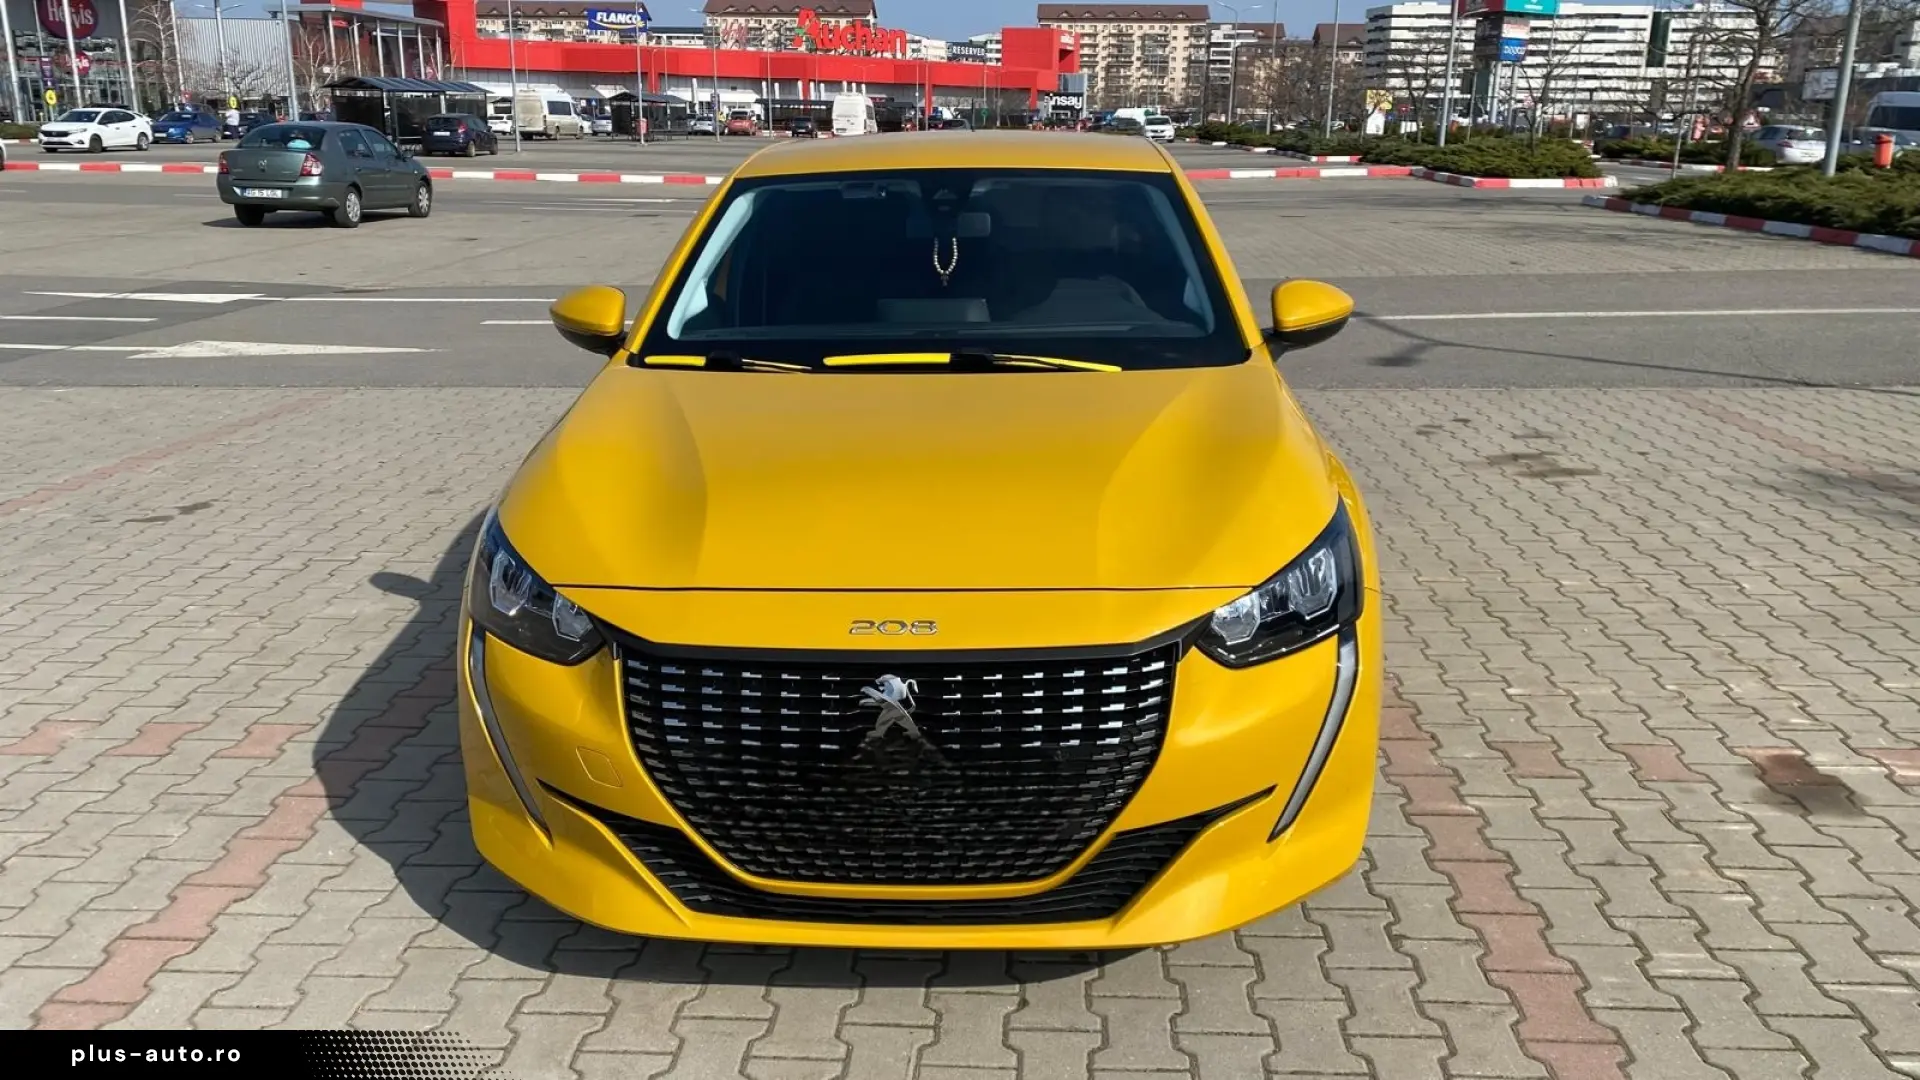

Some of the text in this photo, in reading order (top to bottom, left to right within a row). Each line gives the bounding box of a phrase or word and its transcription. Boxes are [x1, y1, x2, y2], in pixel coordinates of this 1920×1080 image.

[596, 11, 642, 24] FLANCO
[792, 7, 907, 55] Auchan
[953, 46, 986, 56] RESERVED
[849, 620, 938, 635] 208
